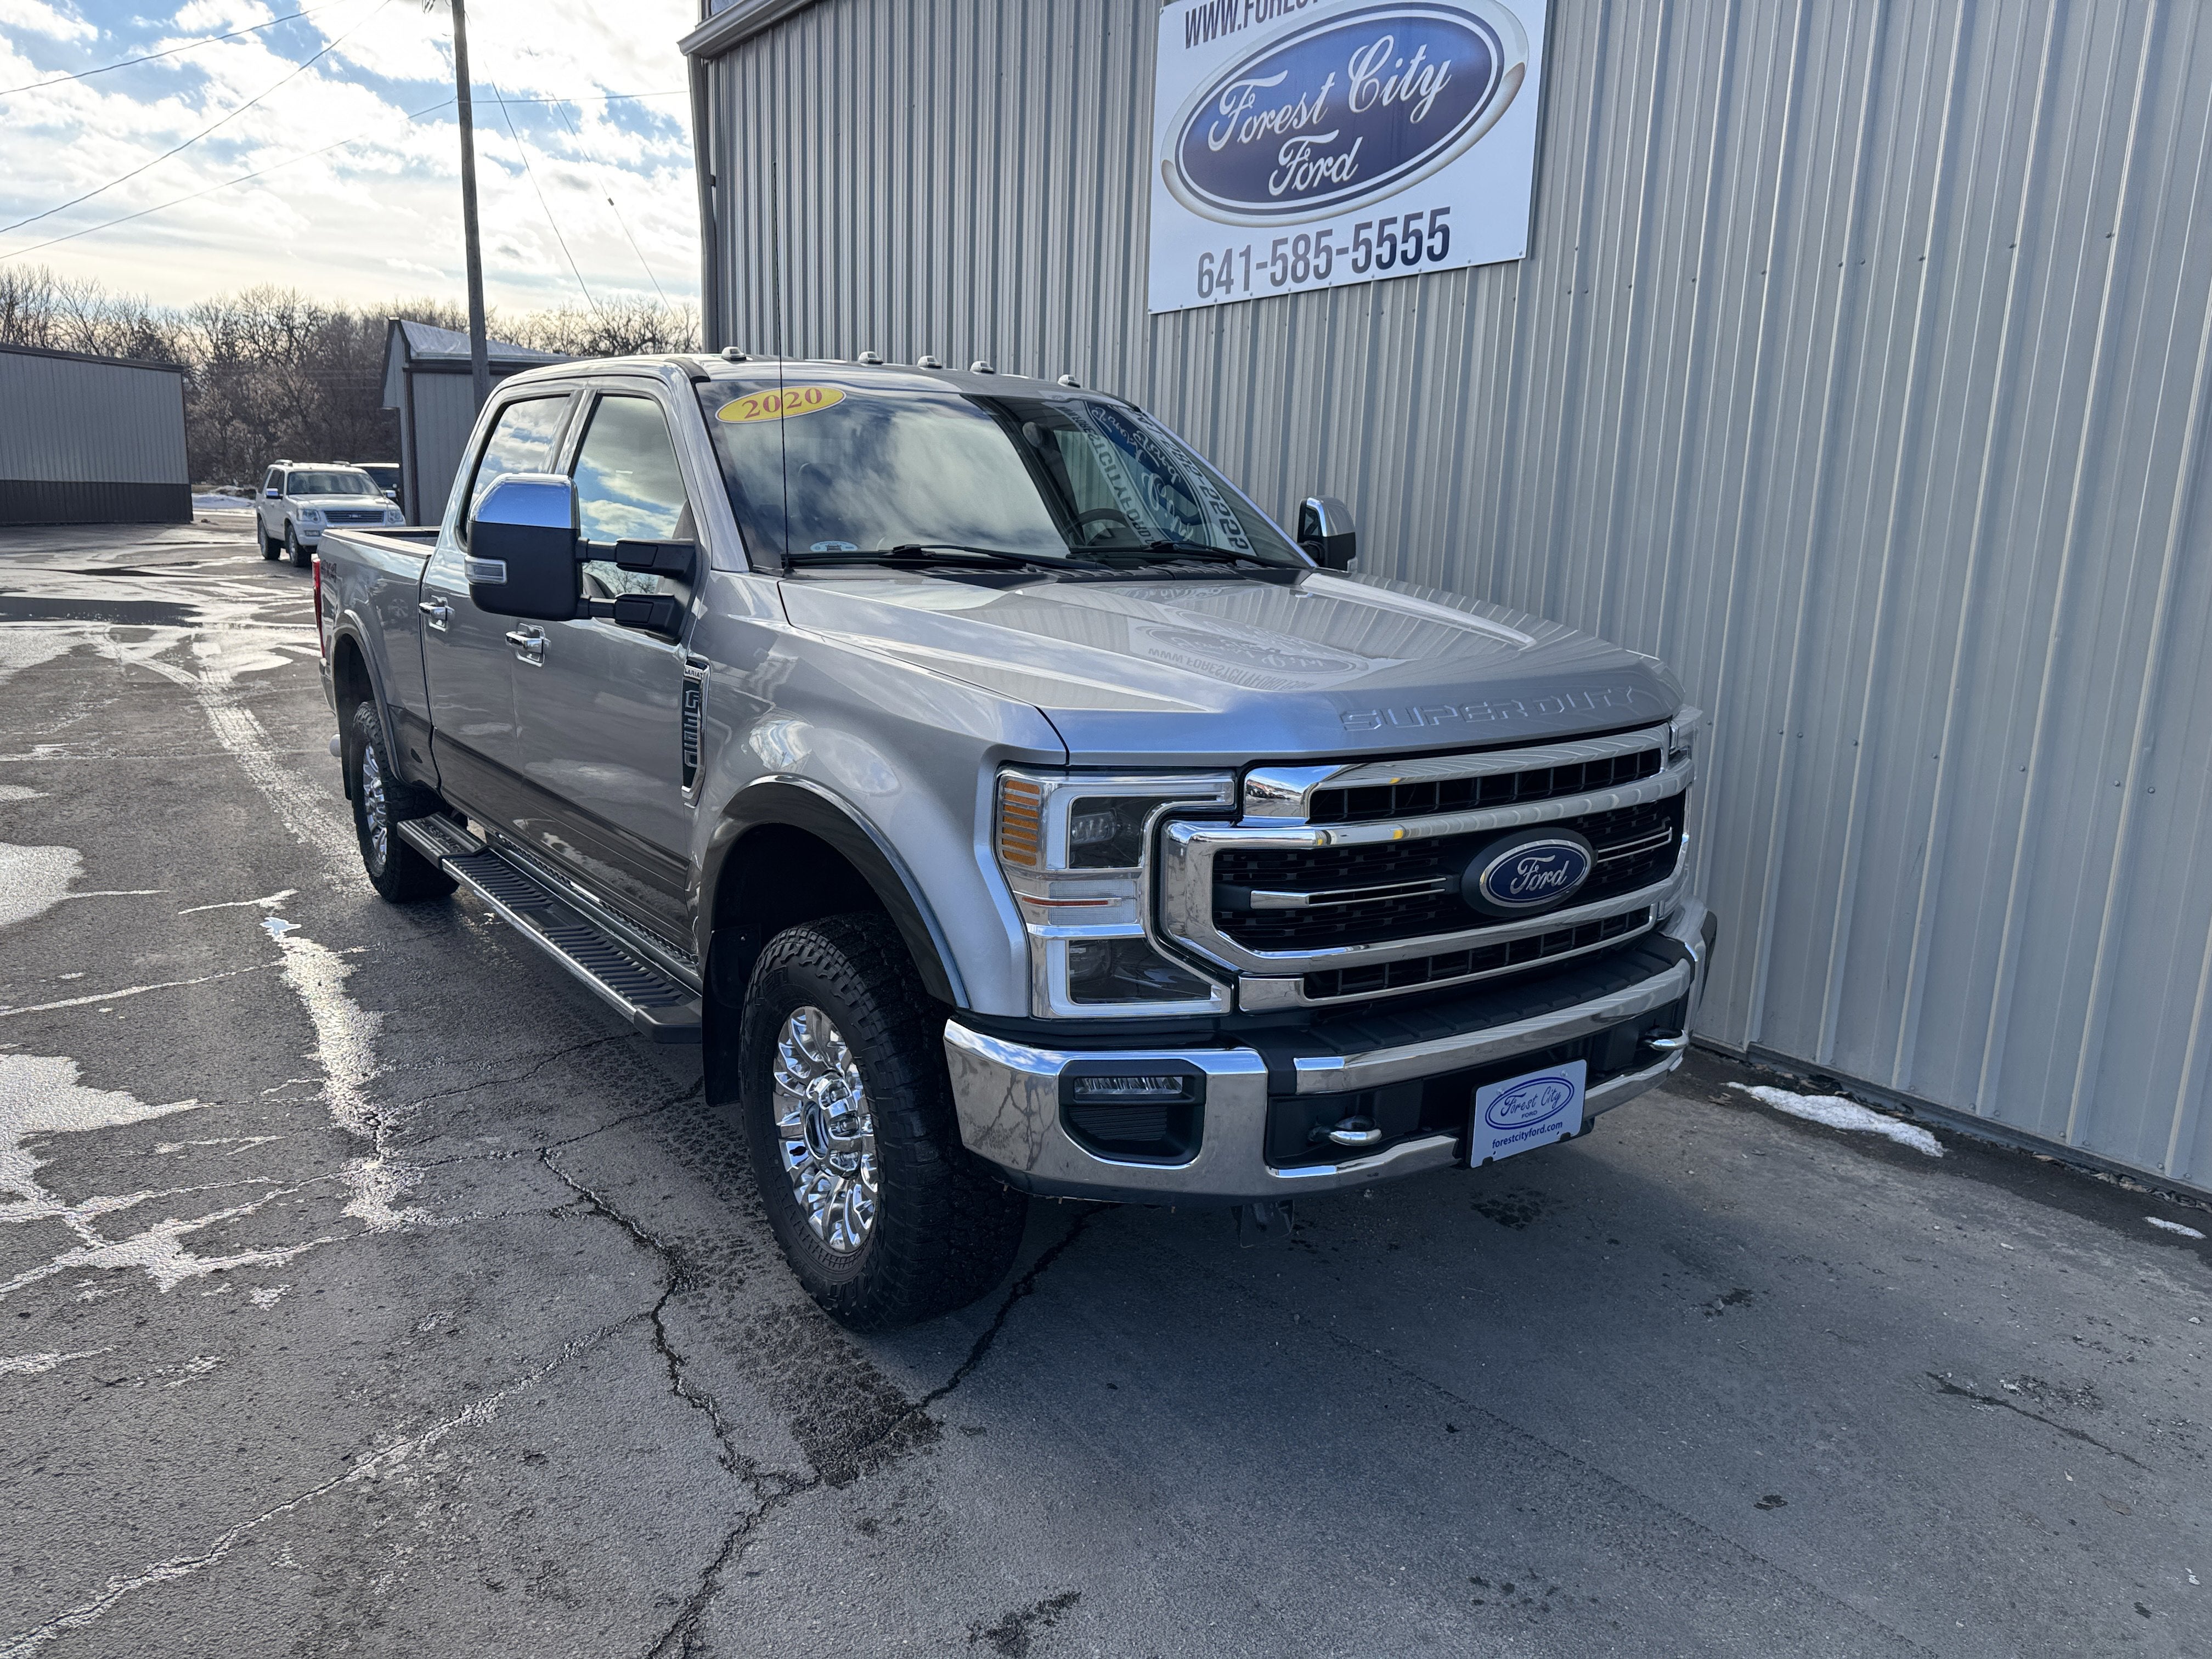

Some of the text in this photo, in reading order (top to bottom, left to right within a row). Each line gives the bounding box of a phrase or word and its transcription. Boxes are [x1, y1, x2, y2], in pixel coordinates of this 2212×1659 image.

[1207, 34, 1452, 151] Forest City
[1268, 128, 1363, 196] Ford
[1197, 206, 1451, 299] 641-585-5555
[742, 388, 822, 419] 2020
[685, 668, 703, 680] LARIAT
[1339, 685, 1636, 732] SUPER DUTY
[1510, 854, 1570, 894] Ford
[1500, 1086, 1561, 1117] Forest City
[1521, 1110, 1538, 1119] FORD
[1492, 1121, 1563, 1149] forestcityford.com
